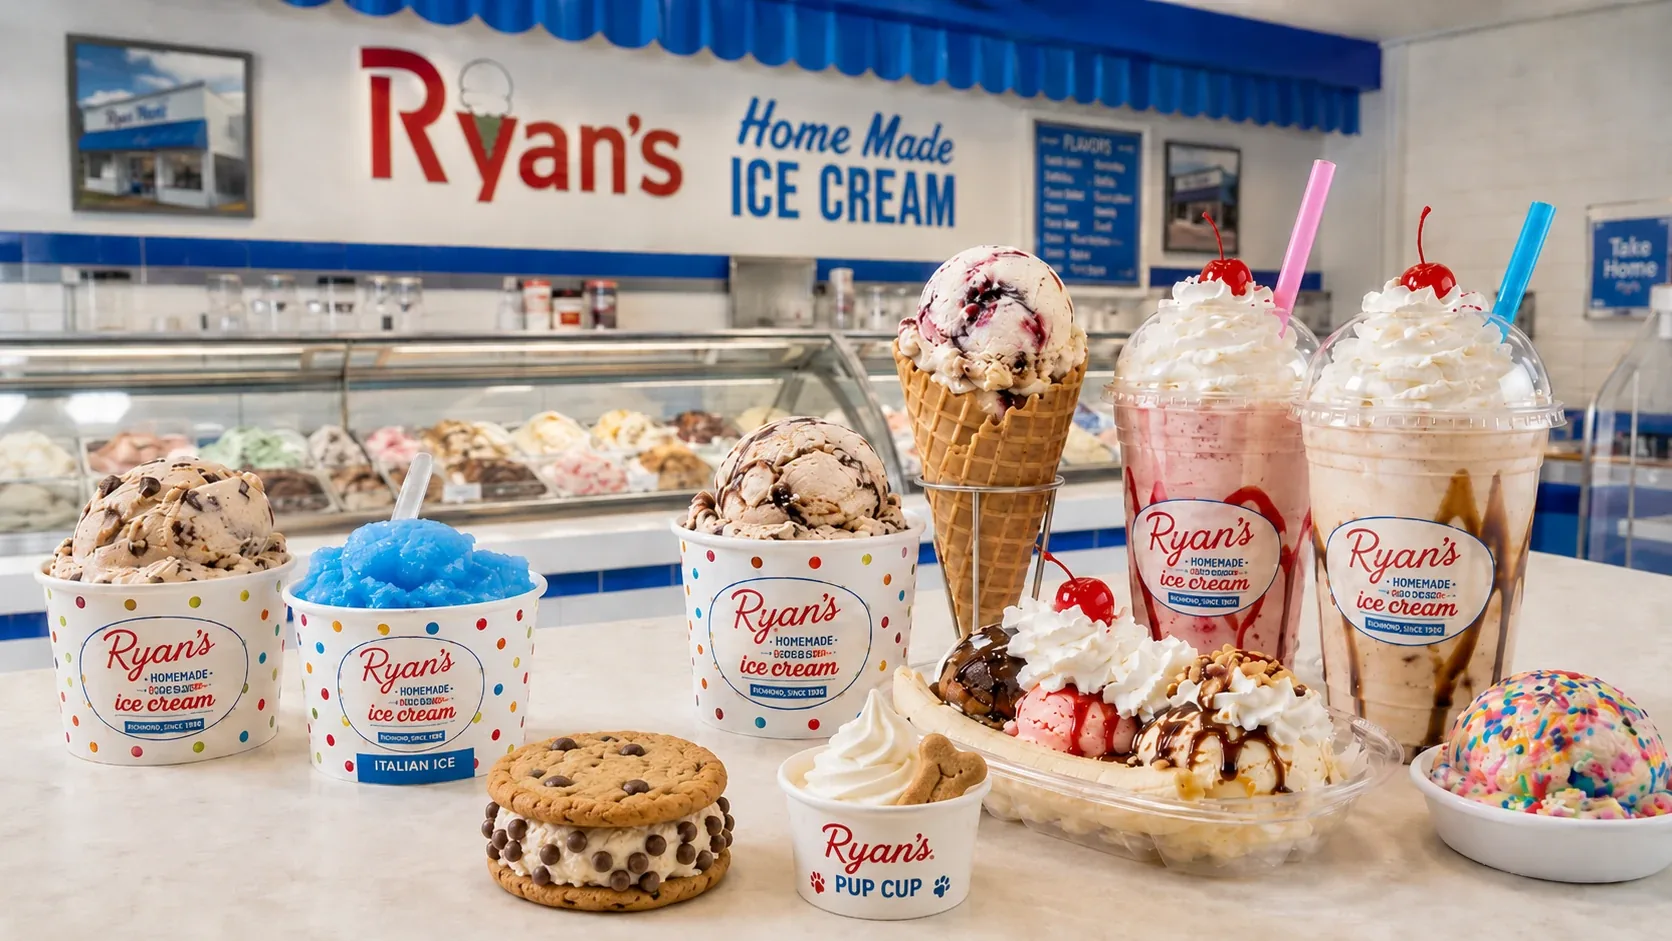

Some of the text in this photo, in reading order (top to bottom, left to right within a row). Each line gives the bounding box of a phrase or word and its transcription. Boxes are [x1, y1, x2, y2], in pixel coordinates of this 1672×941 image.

[360, 46, 684, 203] Ryan's
[737, 97, 955, 165] Home Made
[731, 156, 956, 228] ICE CREAM
[1608, 234, 1652, 258] Take
[1603, 258, 1658, 279] Home
[1146, 511, 1254, 567] Ryan's
[1191, 557, 1244, 568] HOMEMADE
[1346, 528, 1461, 584] Ryan's
[1160, 570, 1185, 588] ice
[1188, 576, 1250, 591] cream
[1393, 577, 1451, 589] HOMEMADE
[1356, 590, 1385, 612] ice
[1388, 599, 1458, 617] cream
[731, 589, 841, 644] Ryan's
[775, 635, 833, 647] HOMEMADE
[103, 629, 215, 682] Ryan's
[739, 655, 840, 677] ice cream
[150, 669, 208, 683] HOMEMADE
[359, 647, 455, 694] Ryan's
[400, 684, 449, 696] HOMEMADE
[114, 693, 216, 712] ice cream
[368, 704, 457, 722] ice cream
[374, 757, 456, 772] ITALIAN ICE
[822, 823, 933, 874] Ryan's
[835, 874, 922, 898] PUP CUP
